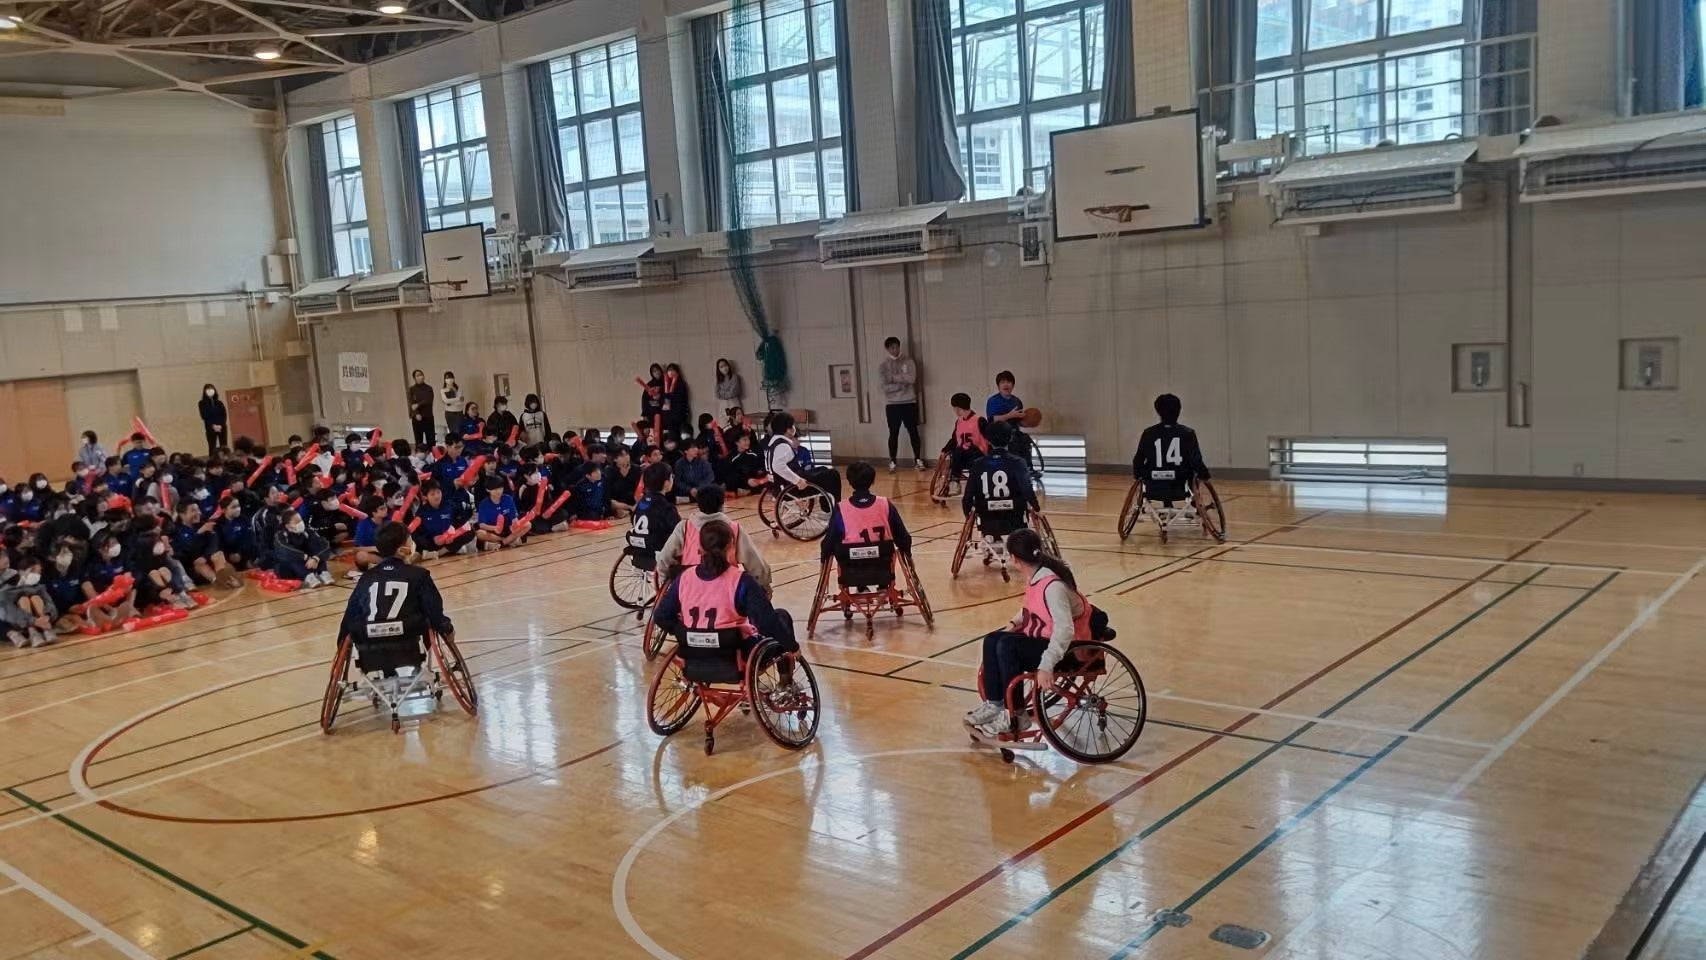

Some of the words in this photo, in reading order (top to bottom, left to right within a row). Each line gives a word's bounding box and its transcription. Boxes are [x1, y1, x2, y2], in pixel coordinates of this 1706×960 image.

[1154, 437, 1183, 468] 14
[980, 470, 1010, 499] 18
[367, 581, 409, 621] 17
[688, 607, 717, 630] 11
